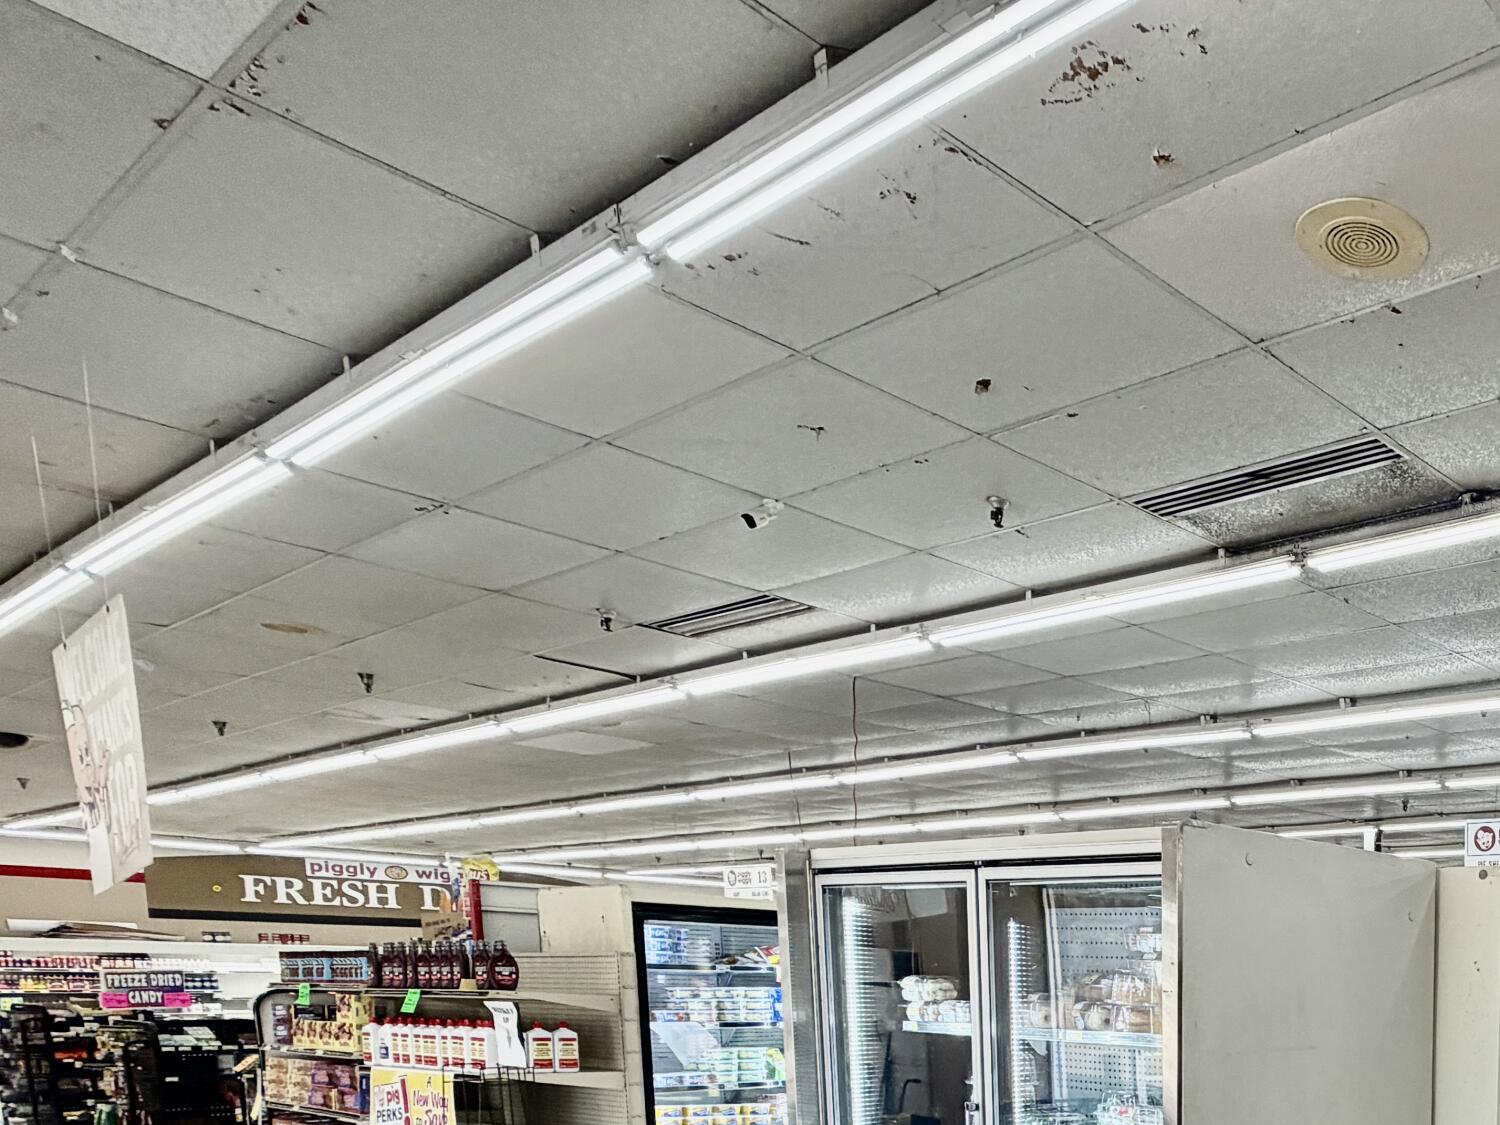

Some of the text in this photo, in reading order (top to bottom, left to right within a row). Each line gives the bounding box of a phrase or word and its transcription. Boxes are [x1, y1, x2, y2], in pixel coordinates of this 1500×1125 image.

[310, 861, 378, 879] piggly
[415, 868, 451, 883] wig
[239, 873, 402, 910] FRESH
[105, 972, 183, 988] FREEZE DRIED
[128, 990, 165, 1004] CANDY
[386, 1087, 400, 1106] pig
[413, 1090, 449, 1112] New Way
[376, 1107, 403, 1124] PERKS
